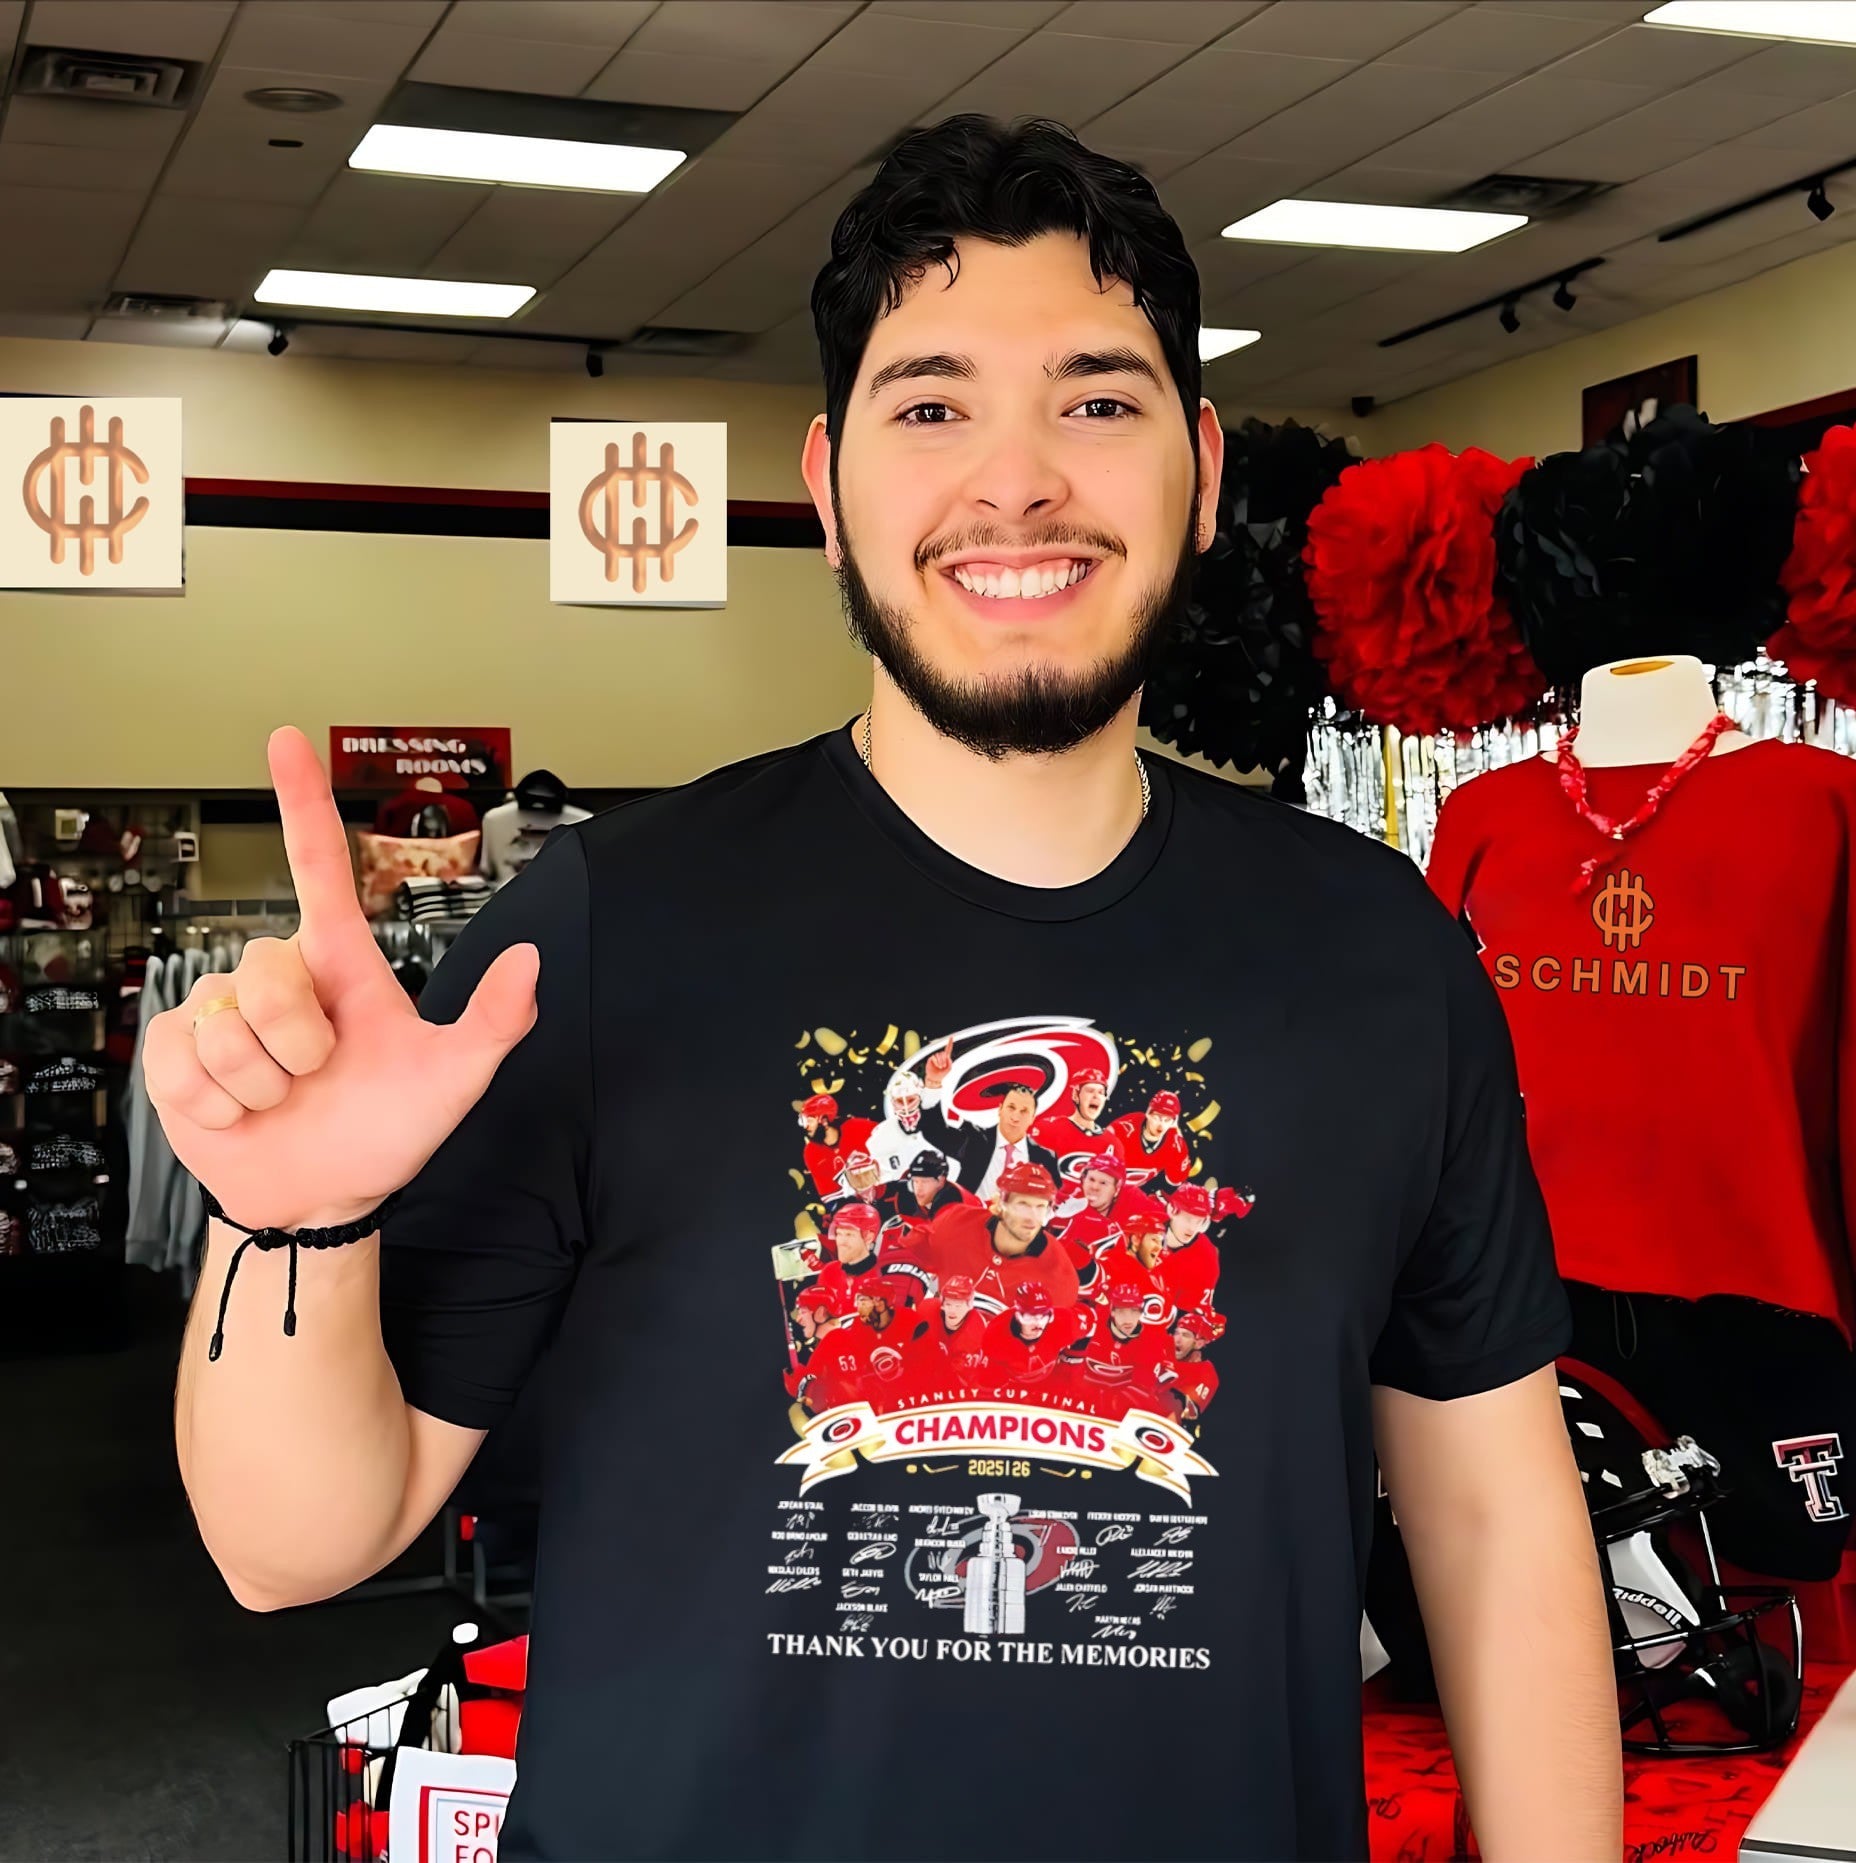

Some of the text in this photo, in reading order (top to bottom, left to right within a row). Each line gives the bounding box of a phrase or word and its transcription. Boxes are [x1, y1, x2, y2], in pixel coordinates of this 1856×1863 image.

[396, 759, 487, 775] ROOMS
[1494, 953, 1746, 1000] SCHMIDT
[897, 1387, 1097, 1415] STANLEY CUP FINAL
[895, 1414, 1105, 1453] CHAMPIONS
[767, 1632, 1212, 1670] THANK YOU FOR THE MEMORIES
